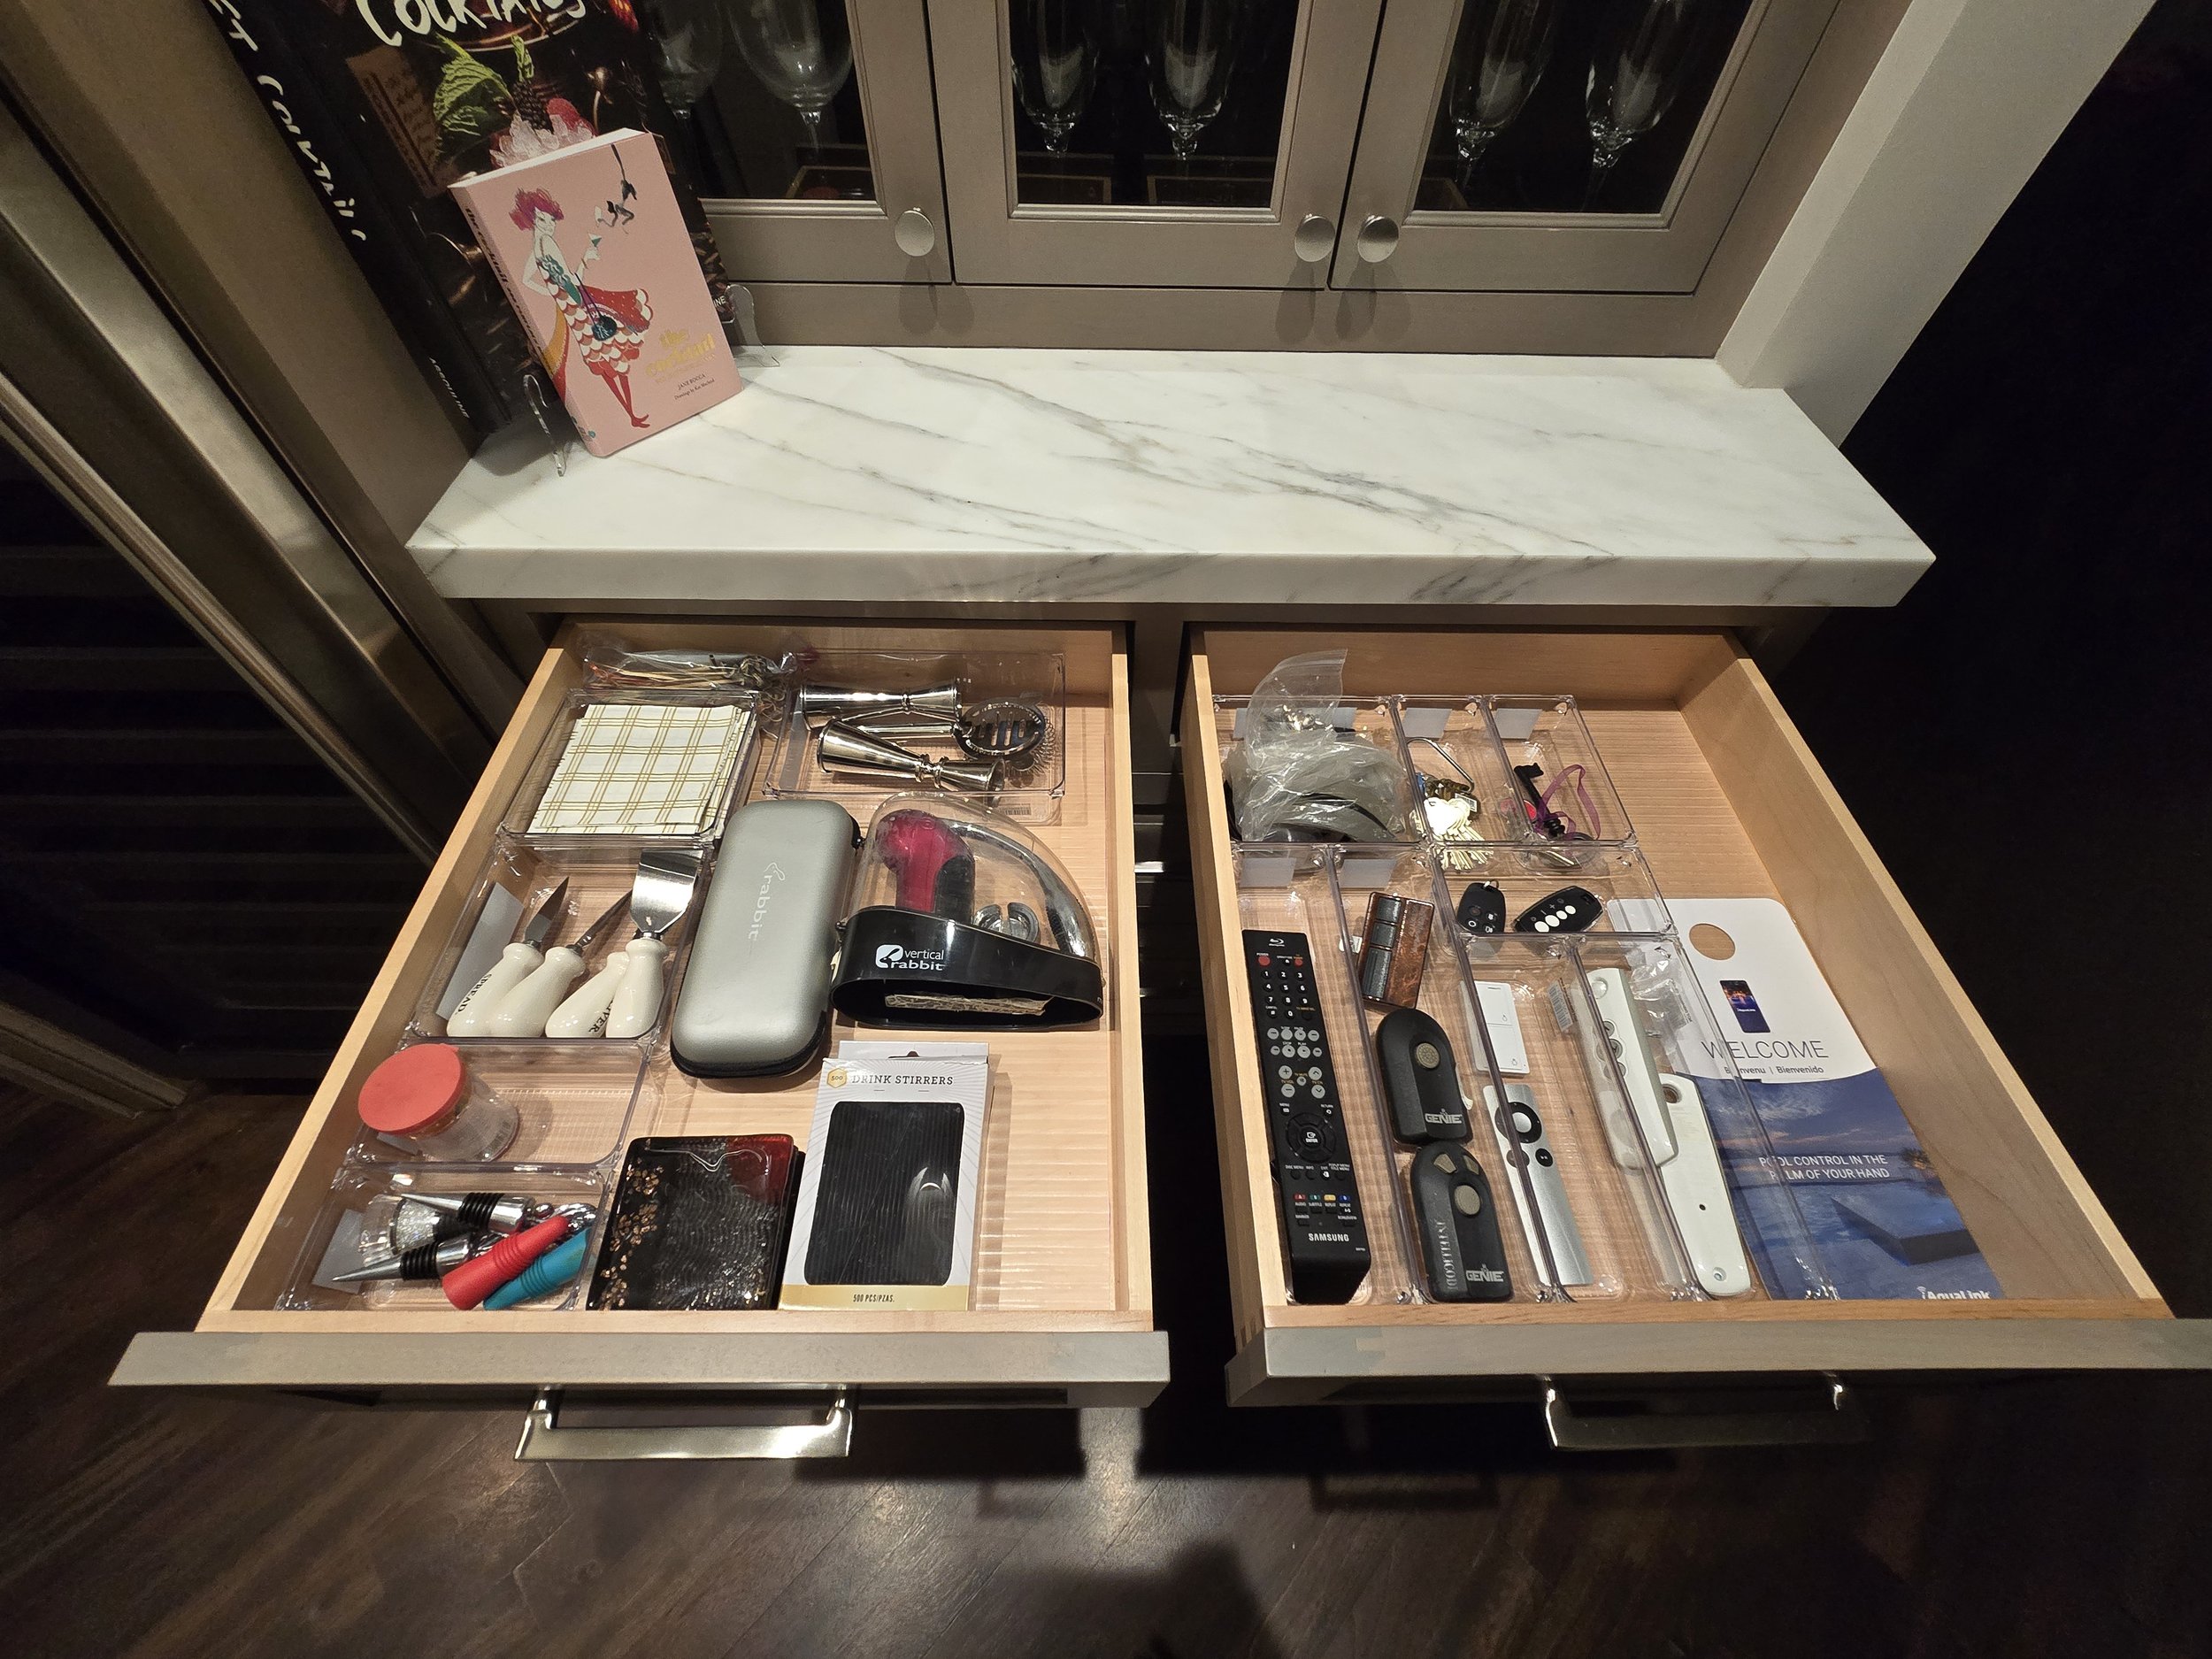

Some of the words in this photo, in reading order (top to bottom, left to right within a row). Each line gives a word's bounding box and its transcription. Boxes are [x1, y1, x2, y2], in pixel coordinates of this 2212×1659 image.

[748, 874, 772, 941] rabbit
[904, 949, 944, 960] vertical
[890, 960, 948, 971] rabbit
[1701, 1041, 1829, 1059] WELCOME
[1776, 1065, 1824, 1074] Bienvenido
[851, 1074, 892, 1085] DRINK
[895, 1075, 954, 1086] STIRRERS
[1425, 1112, 1463, 1124] GENIE
[1793, 1156, 1849, 1166] CONTROL
[1849, 1155, 1863, 1165] IN
[1863, 1155, 1888, 1165] THE
[1806, 1169, 1821, 1179] OF
[1822, 1169, 1855, 1179] YOUR
[1855, 1168, 1890, 1179] HAND
[1466, 1269, 1504, 1282] GENIE
[853, 1294, 864, 1303] 500
[864, 1294, 895, 1303] PCS/PZAS.
